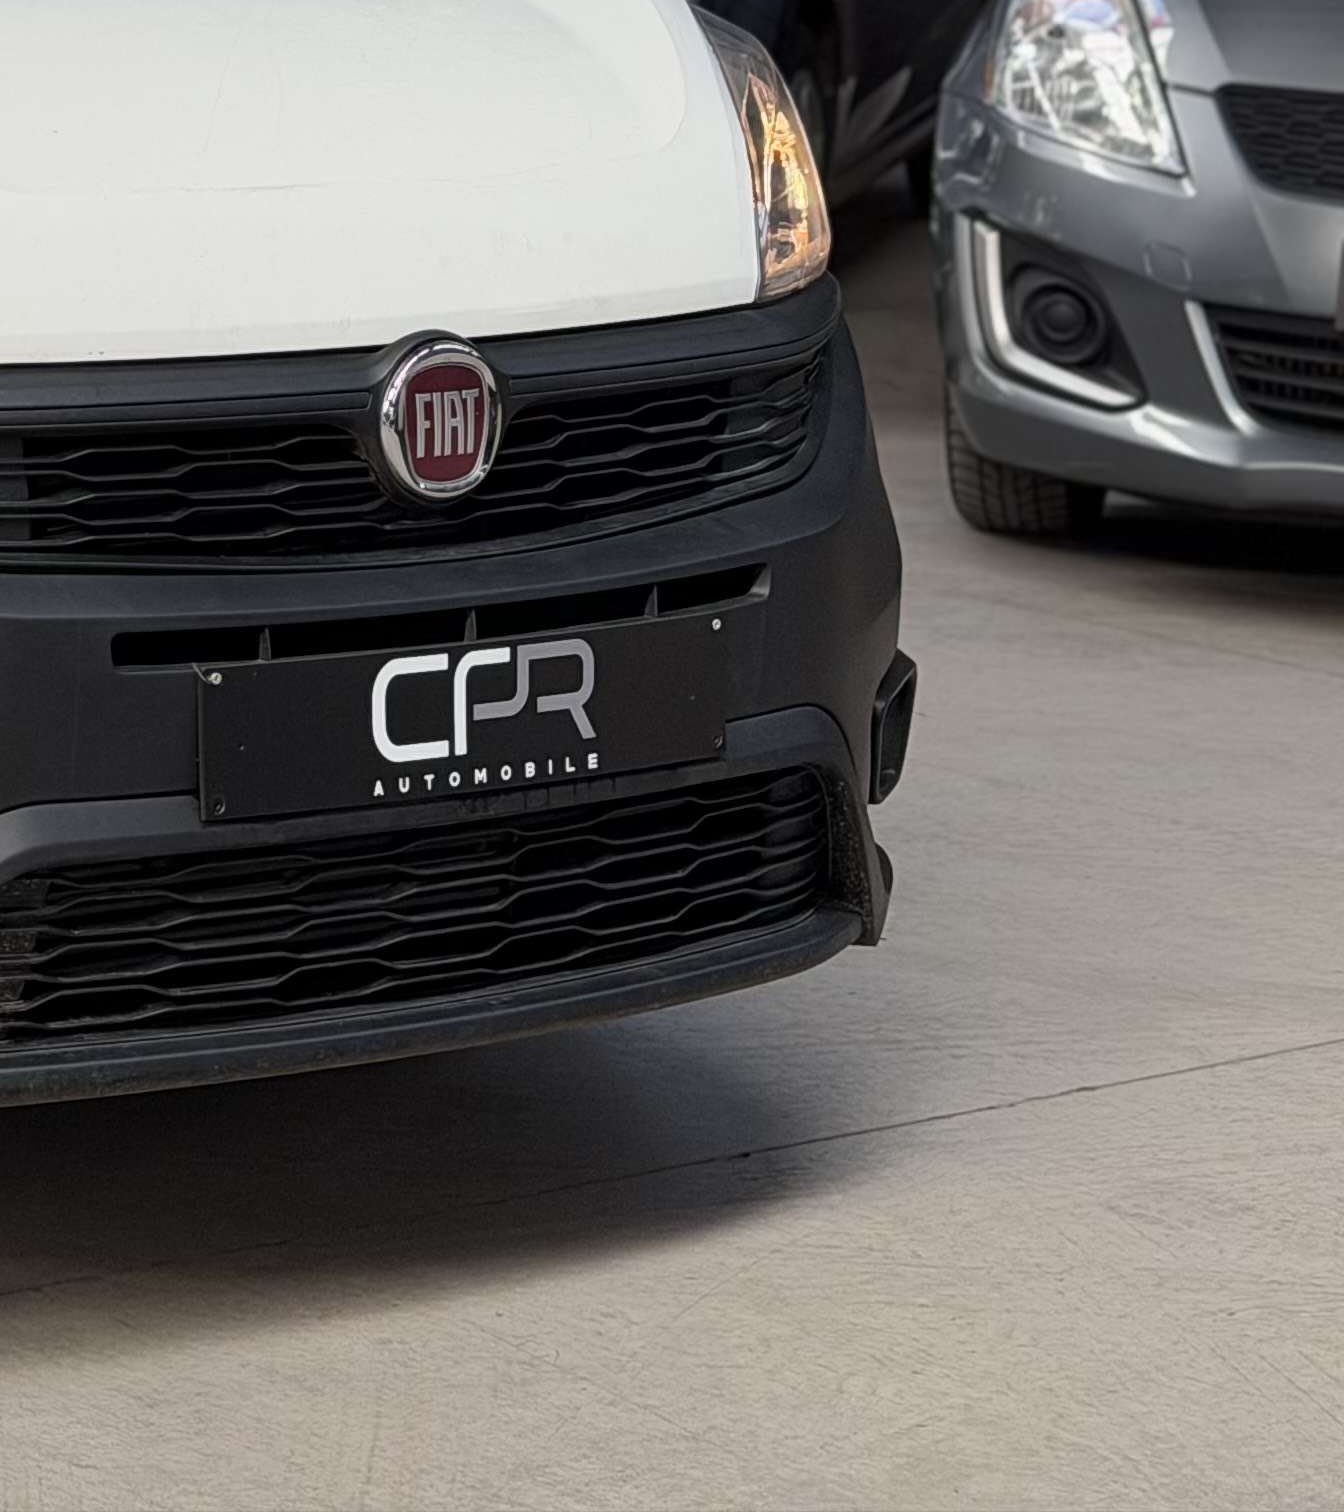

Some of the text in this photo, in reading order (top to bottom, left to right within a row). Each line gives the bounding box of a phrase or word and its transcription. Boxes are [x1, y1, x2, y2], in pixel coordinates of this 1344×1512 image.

[415, 389, 479, 459] FIAT
[372, 638, 597, 762] CPR
[373, 752, 599, 797] AUTOMOBILE
